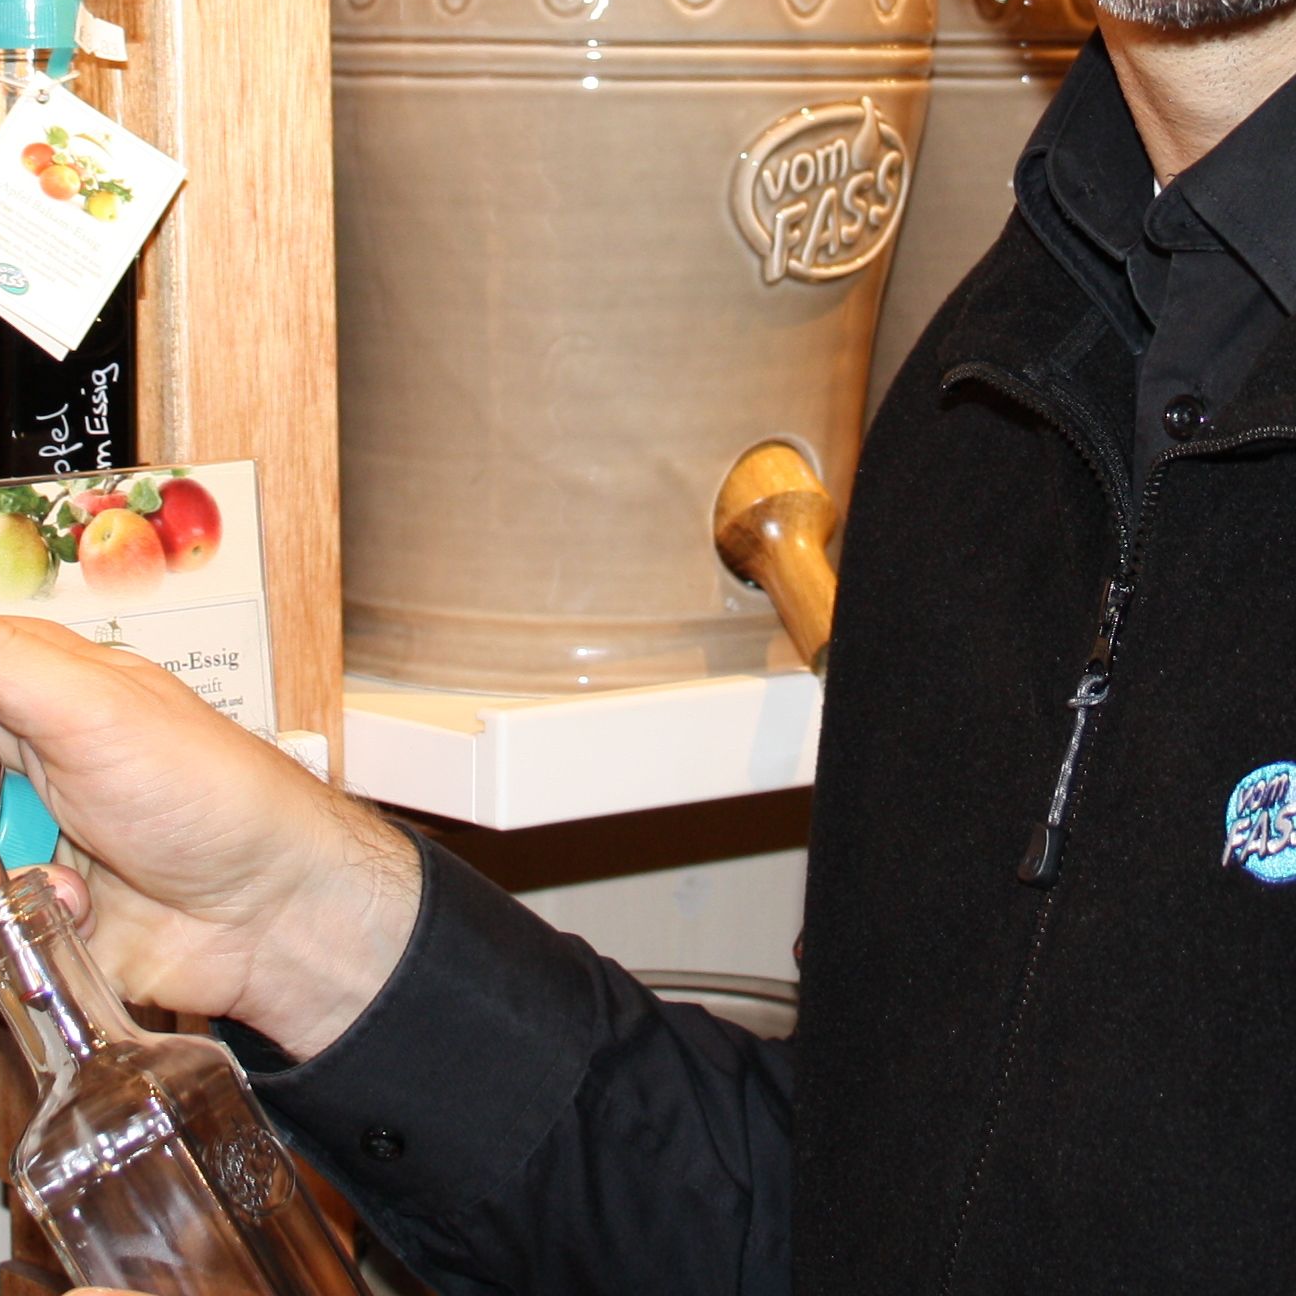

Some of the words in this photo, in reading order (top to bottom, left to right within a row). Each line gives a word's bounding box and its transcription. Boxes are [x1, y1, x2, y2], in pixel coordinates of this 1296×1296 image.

[760, 137, 852, 201] vom
[765, 150, 904, 284] FASS
[80, 362, 120, 436] Essig
[1237, 772, 1290, 816] vom
